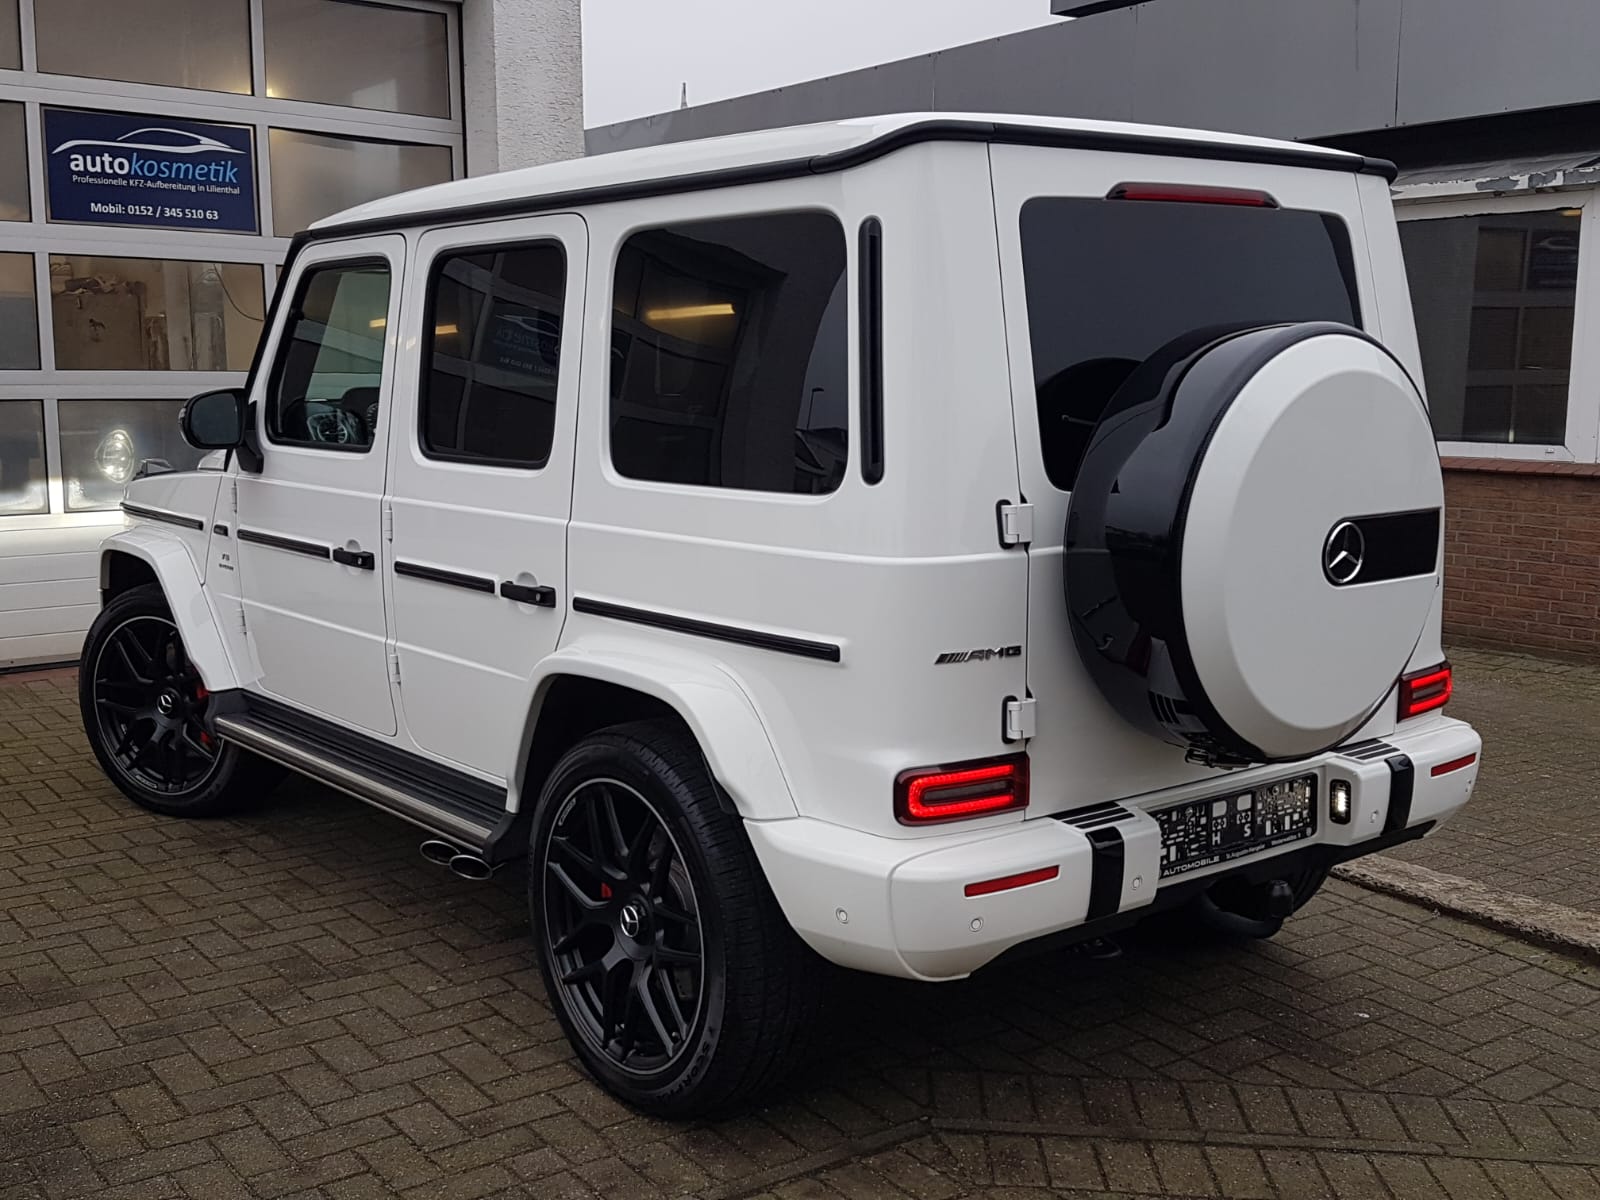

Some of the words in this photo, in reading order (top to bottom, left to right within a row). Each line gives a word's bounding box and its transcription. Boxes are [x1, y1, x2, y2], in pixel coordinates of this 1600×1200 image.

[69, 152, 239, 183] autokosmetik
[72, 174, 128, 187] Professionelle
[129, 179, 196, 192] KFZ-Aufbereitung
[206, 184, 240, 194] Lilienthal
[90, 202, 126, 214] Mobil:
[127, 204, 154, 216] 0152
[155, 205, 161, 218] /
[163, 207, 183, 217] 345
[185, 208, 205, 219] 510
[206, 210, 219, 220] 63
[1162, 854, 1220, 877] AUTOMOBILE
